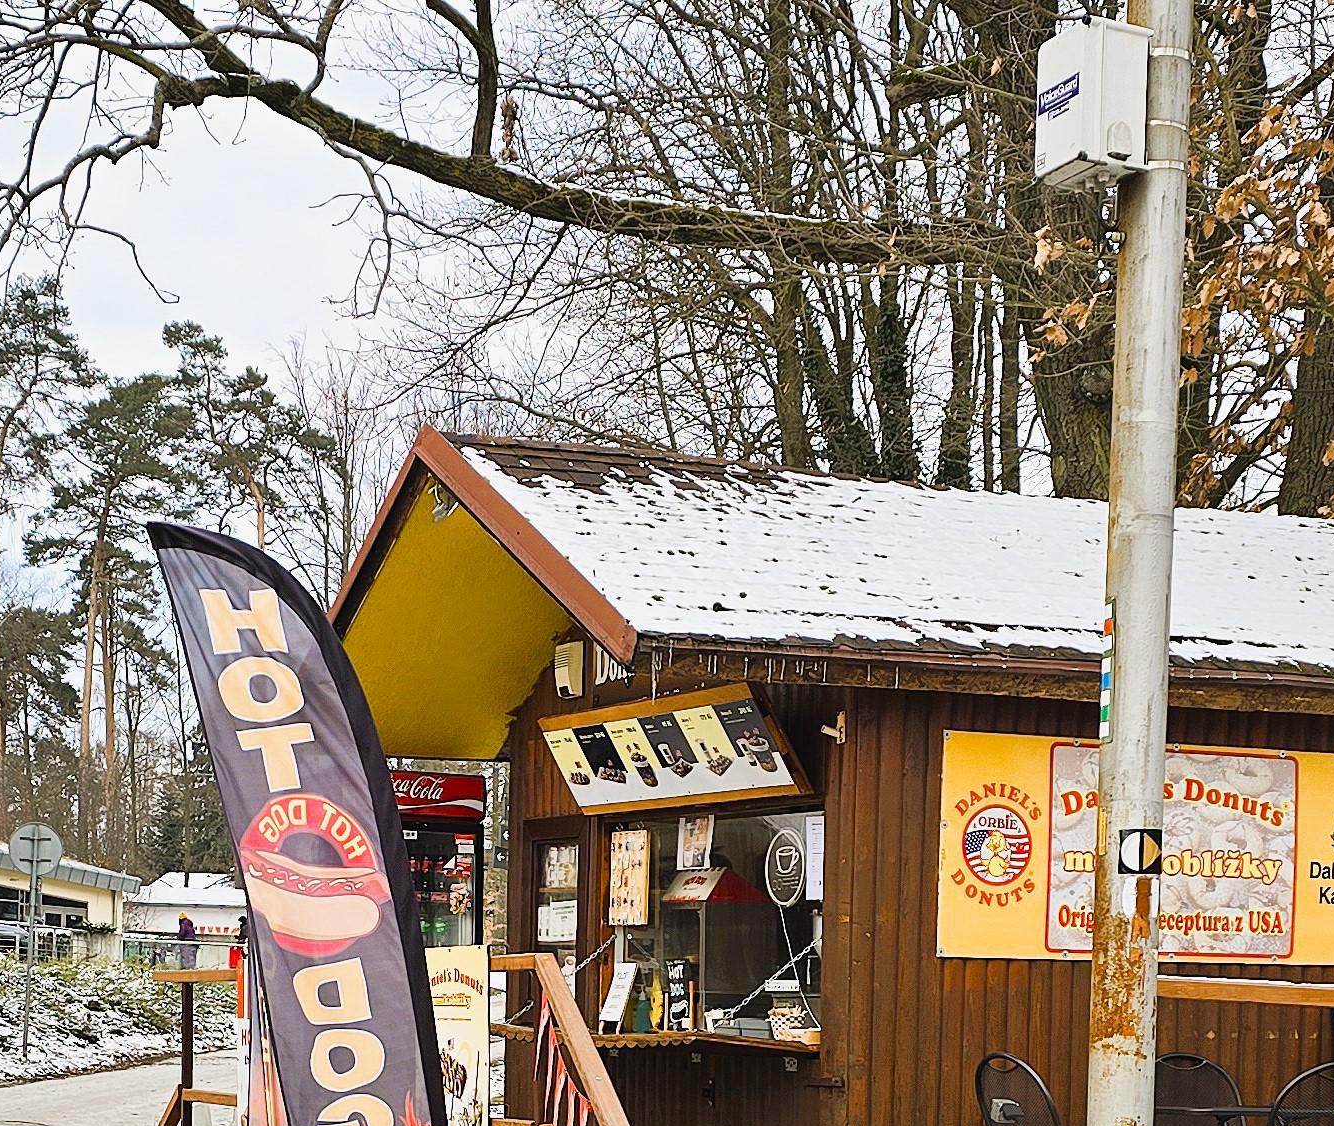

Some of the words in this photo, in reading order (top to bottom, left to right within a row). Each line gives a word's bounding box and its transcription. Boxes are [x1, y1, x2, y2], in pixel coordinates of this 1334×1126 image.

[955, 783, 1042, 821] DANIEL'S
[1183, 778, 1284, 827] Donuts
[978, 815, 1018, 830] ORBIE
[1162, 849, 1283, 885] oblížky
[951, 869, 1036, 907] DONUTS
[1158, 911, 1231, 936] eceptura
[1235, 917, 1244, 933] z
[1248, 910, 1284, 934] USA
[431, 968, 452, 987] niel's
[454, 968, 483, 996] Donuts
[667, 964, 684, 980] HOT
